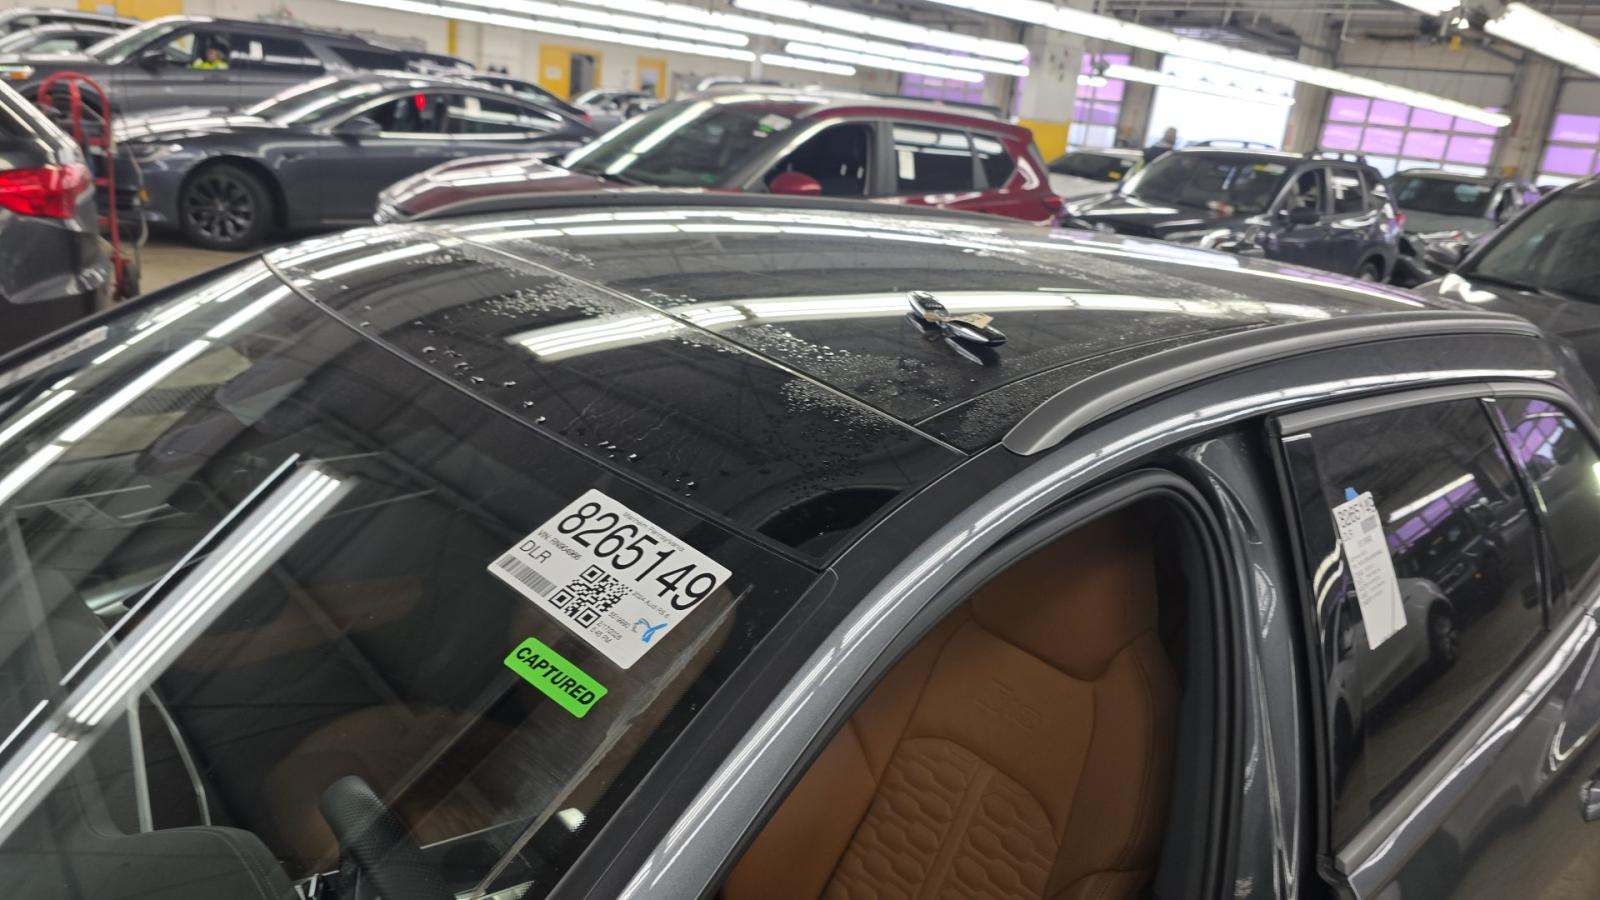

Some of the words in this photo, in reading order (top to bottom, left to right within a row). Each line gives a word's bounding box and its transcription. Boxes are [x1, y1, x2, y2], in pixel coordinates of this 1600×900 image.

[519, 540, 552, 563] DLR
[558, 503, 716, 610] 8265149
[516, 647, 596, 706] CAPTURED
